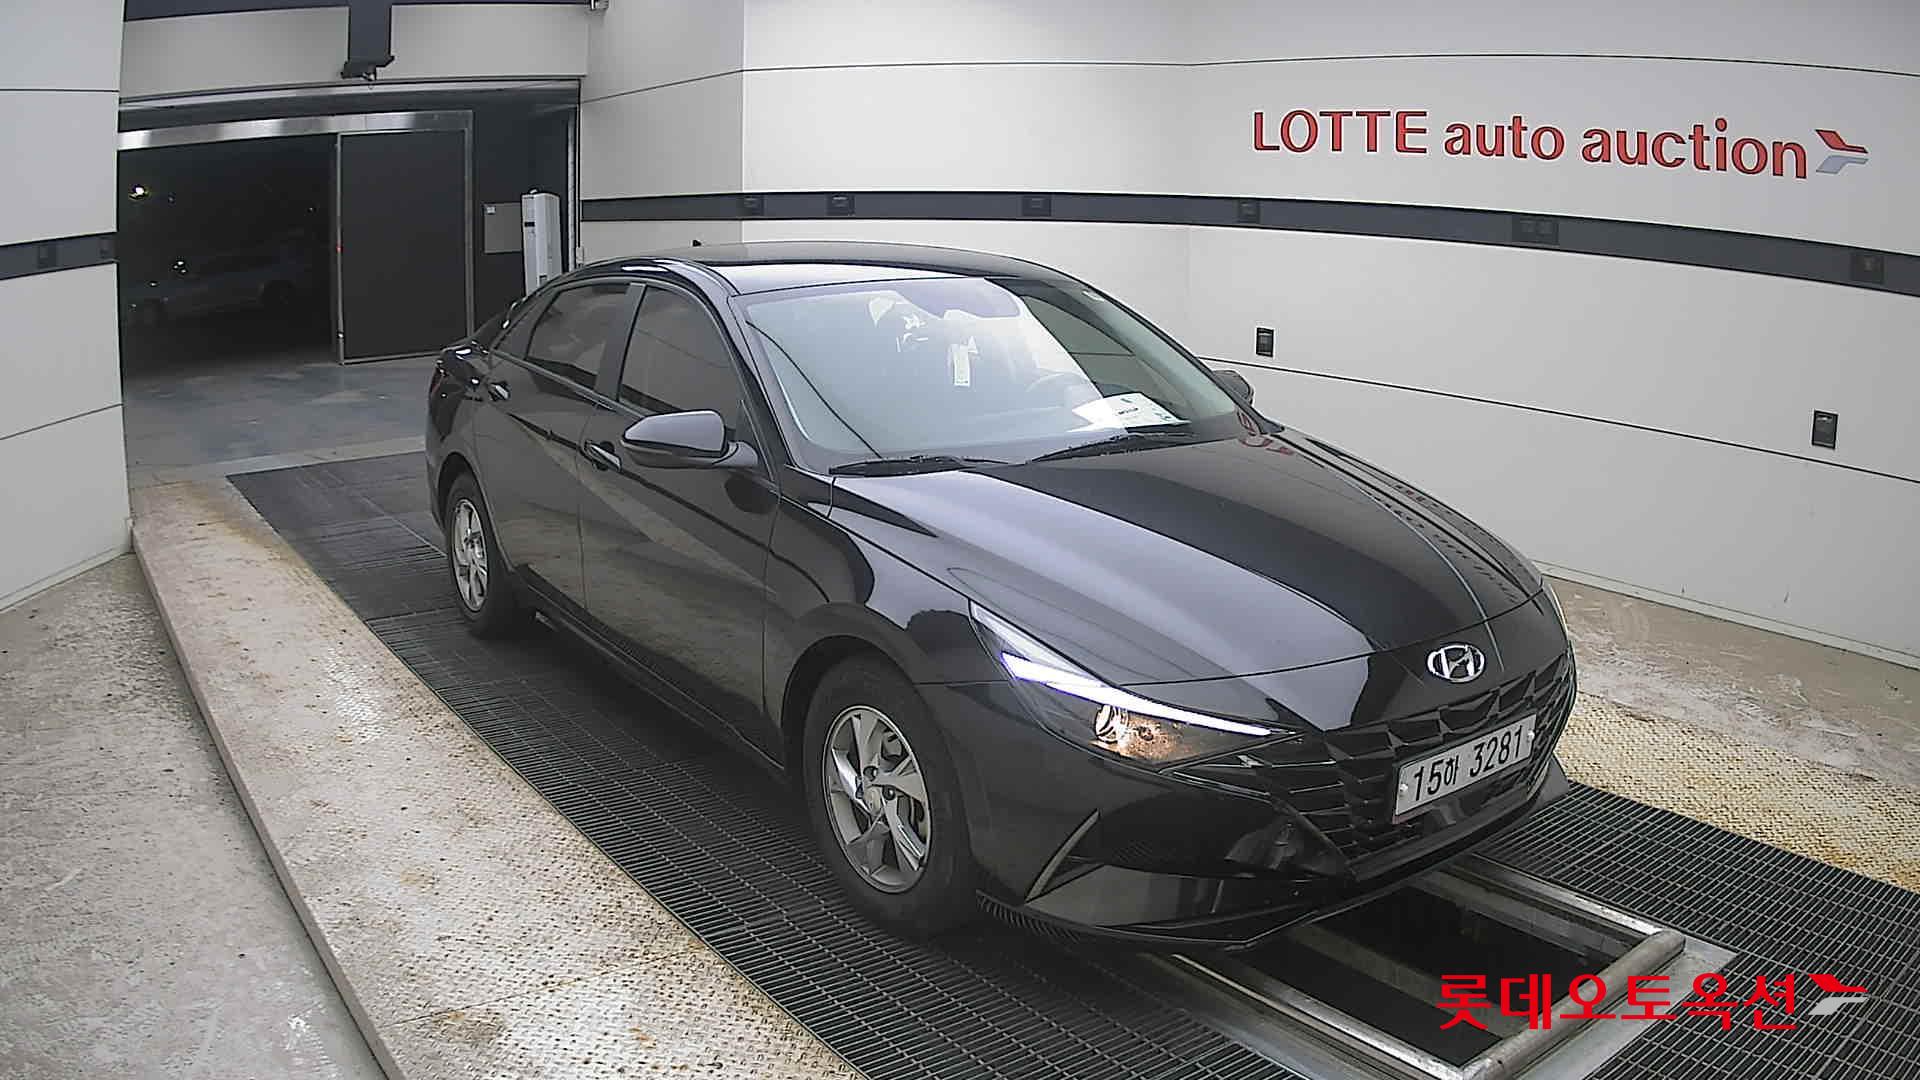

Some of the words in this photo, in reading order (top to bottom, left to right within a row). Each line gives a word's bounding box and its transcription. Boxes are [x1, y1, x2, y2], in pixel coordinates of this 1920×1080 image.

[1253, 109, 1427, 153] LOTTE
[1444, 115, 1565, 160] auto
[1581, 117, 1807, 179] auction
[1414, 755, 1460, 801] 15하
[1469, 725, 1523, 777] 3281
